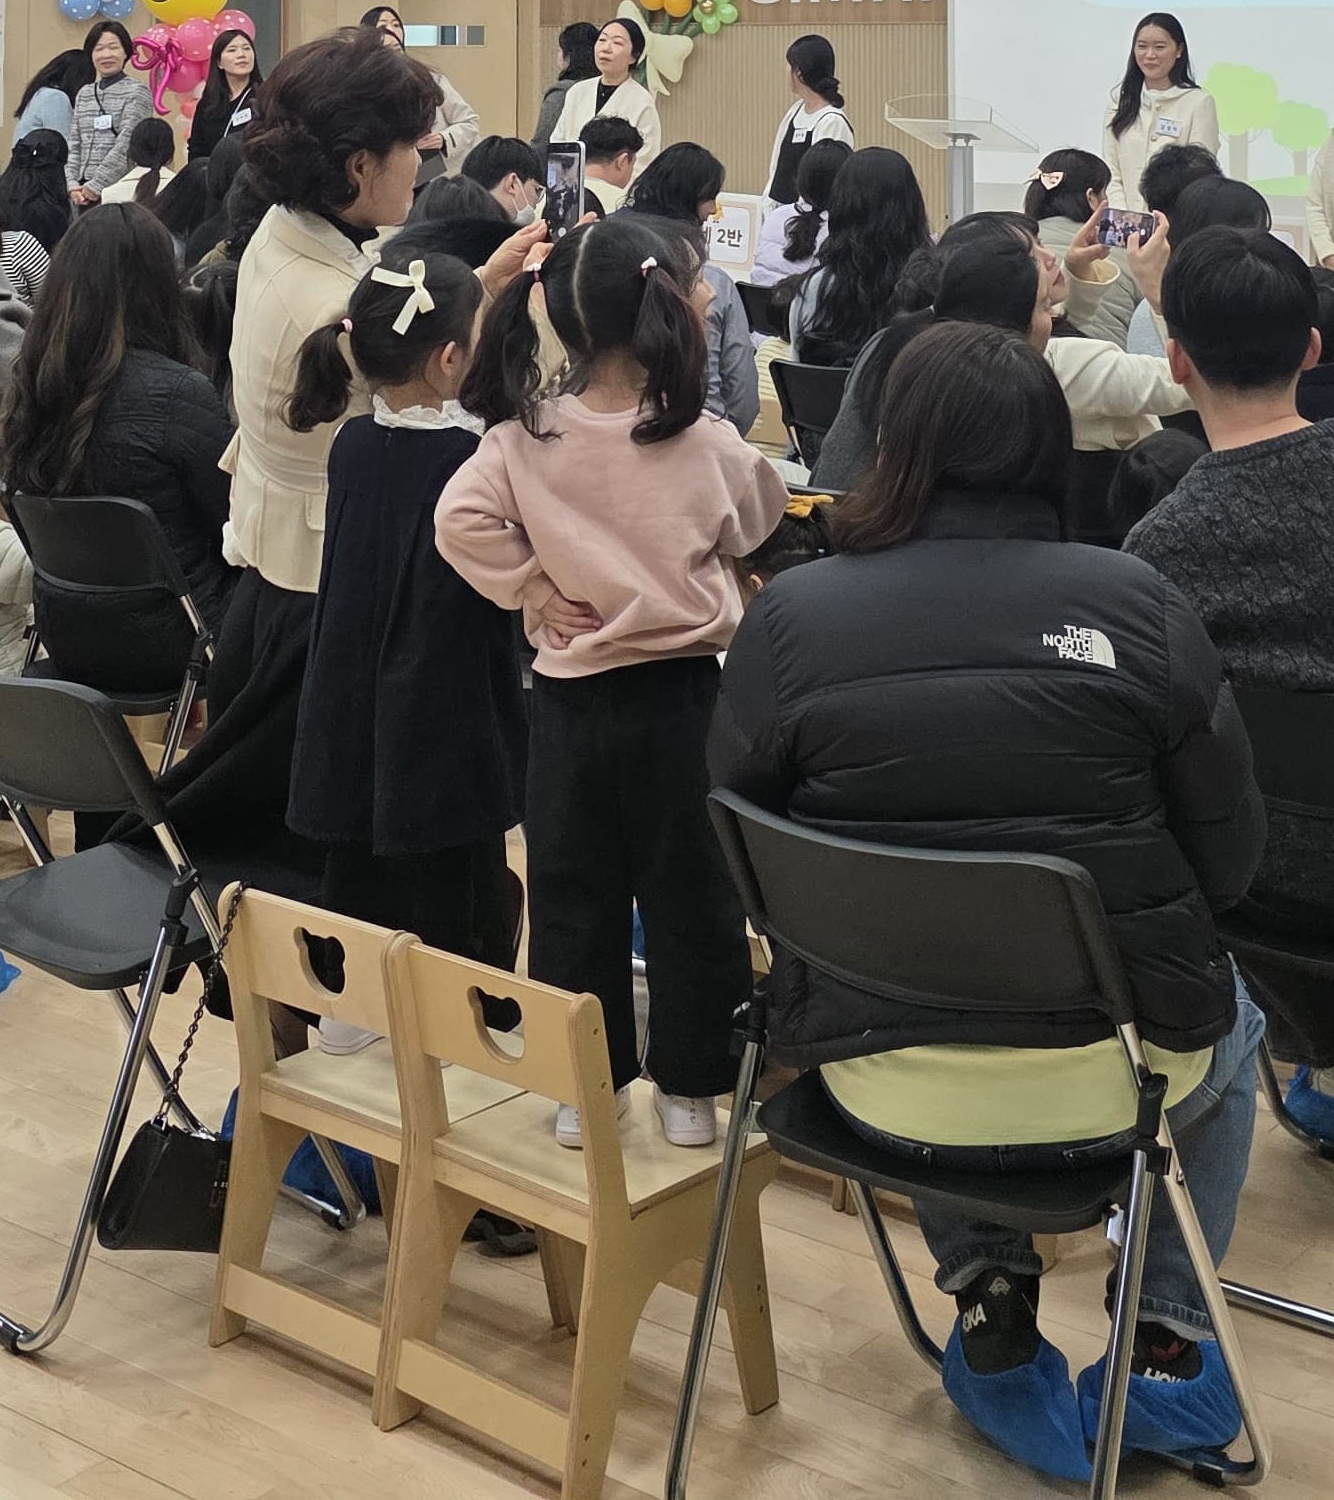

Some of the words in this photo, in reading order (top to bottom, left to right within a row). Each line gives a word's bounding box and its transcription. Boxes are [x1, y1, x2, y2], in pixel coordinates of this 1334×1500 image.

[716, 228, 743, 248] 2반
[1063, 624, 1092, 641] THE
[1042, 633, 1092, 651] NORTH
[1058, 646, 1093, 662] FACE
